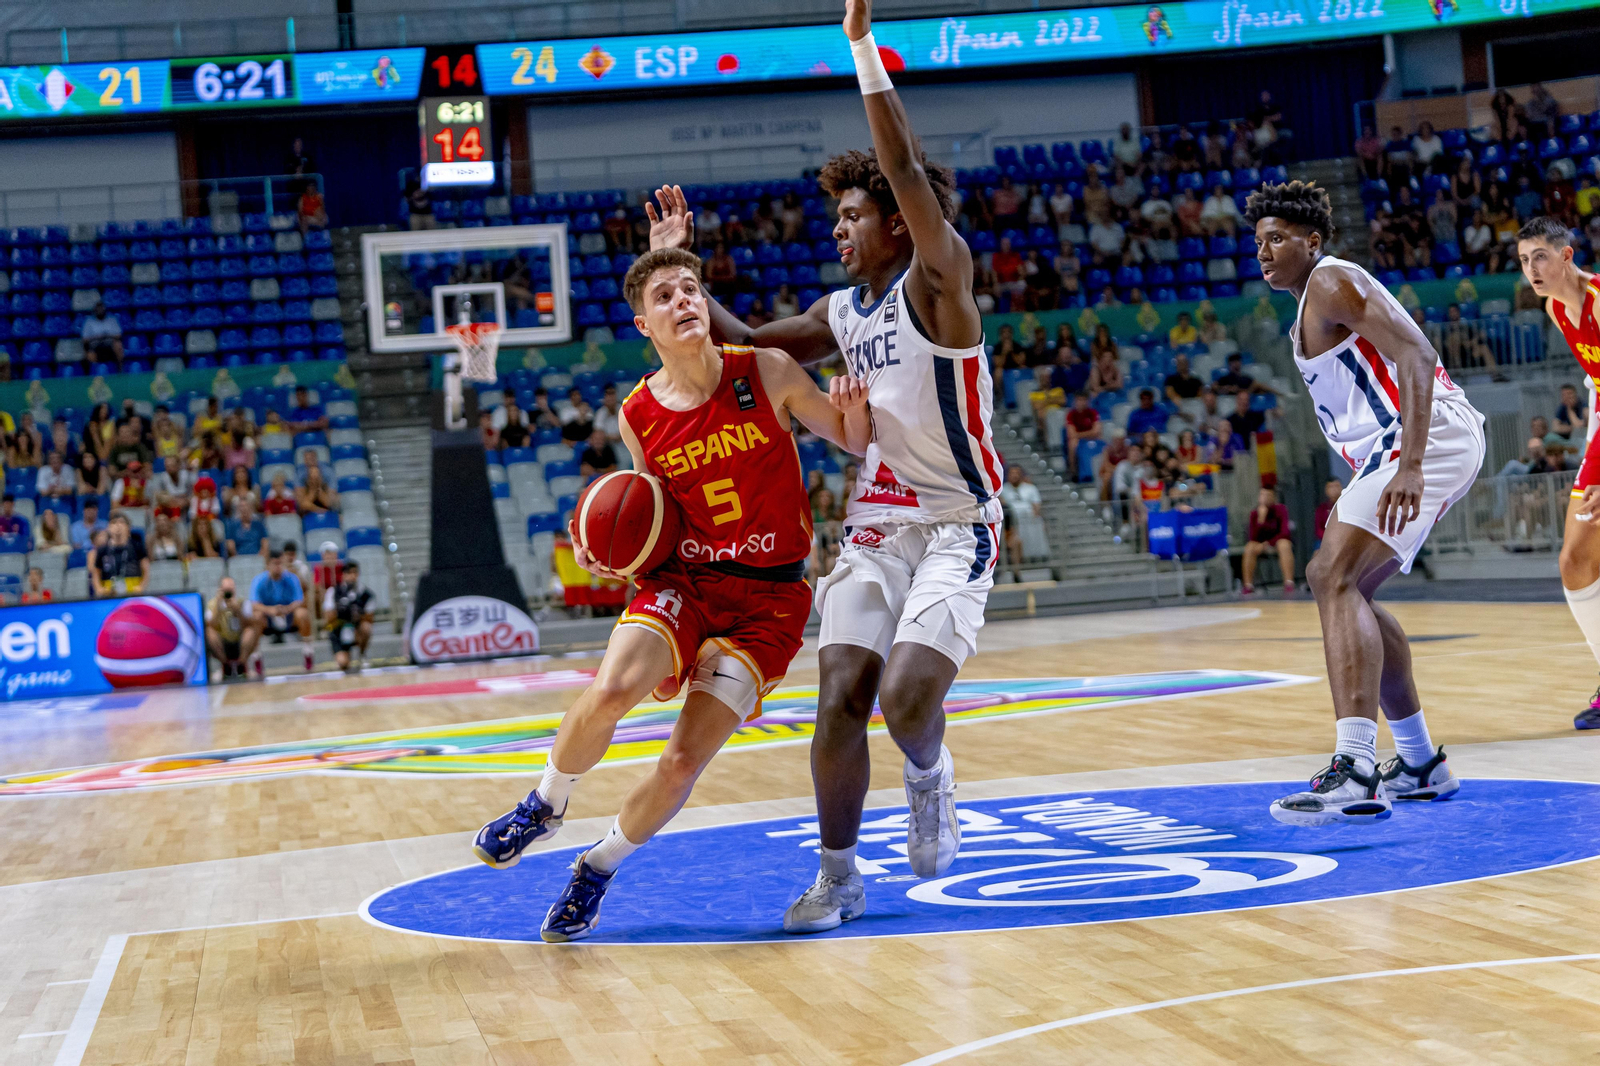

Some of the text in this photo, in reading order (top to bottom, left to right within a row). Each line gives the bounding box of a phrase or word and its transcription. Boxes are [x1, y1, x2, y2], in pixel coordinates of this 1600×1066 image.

[1034, 16, 1102, 46] 2022
[431, 54, 478, 88] 14
[510, 46, 558, 85] 24
[634, 45, 699, 79] ESP
[98, 66, 142, 107] 21
[193, 59, 286, 102] 6:21
[436, 101, 485, 124] 6:21
[433, 127, 485, 163] 14
[654, 421, 769, 479] ESPAÑA
[702, 477, 743, 526] 5
[431, 602, 509, 629] 百岁山
[643, 603, 680, 631] network
[0, 617, 72, 663] en
[6, 668, 72, 699] game
[998, 796, 1239, 851] WANDA
